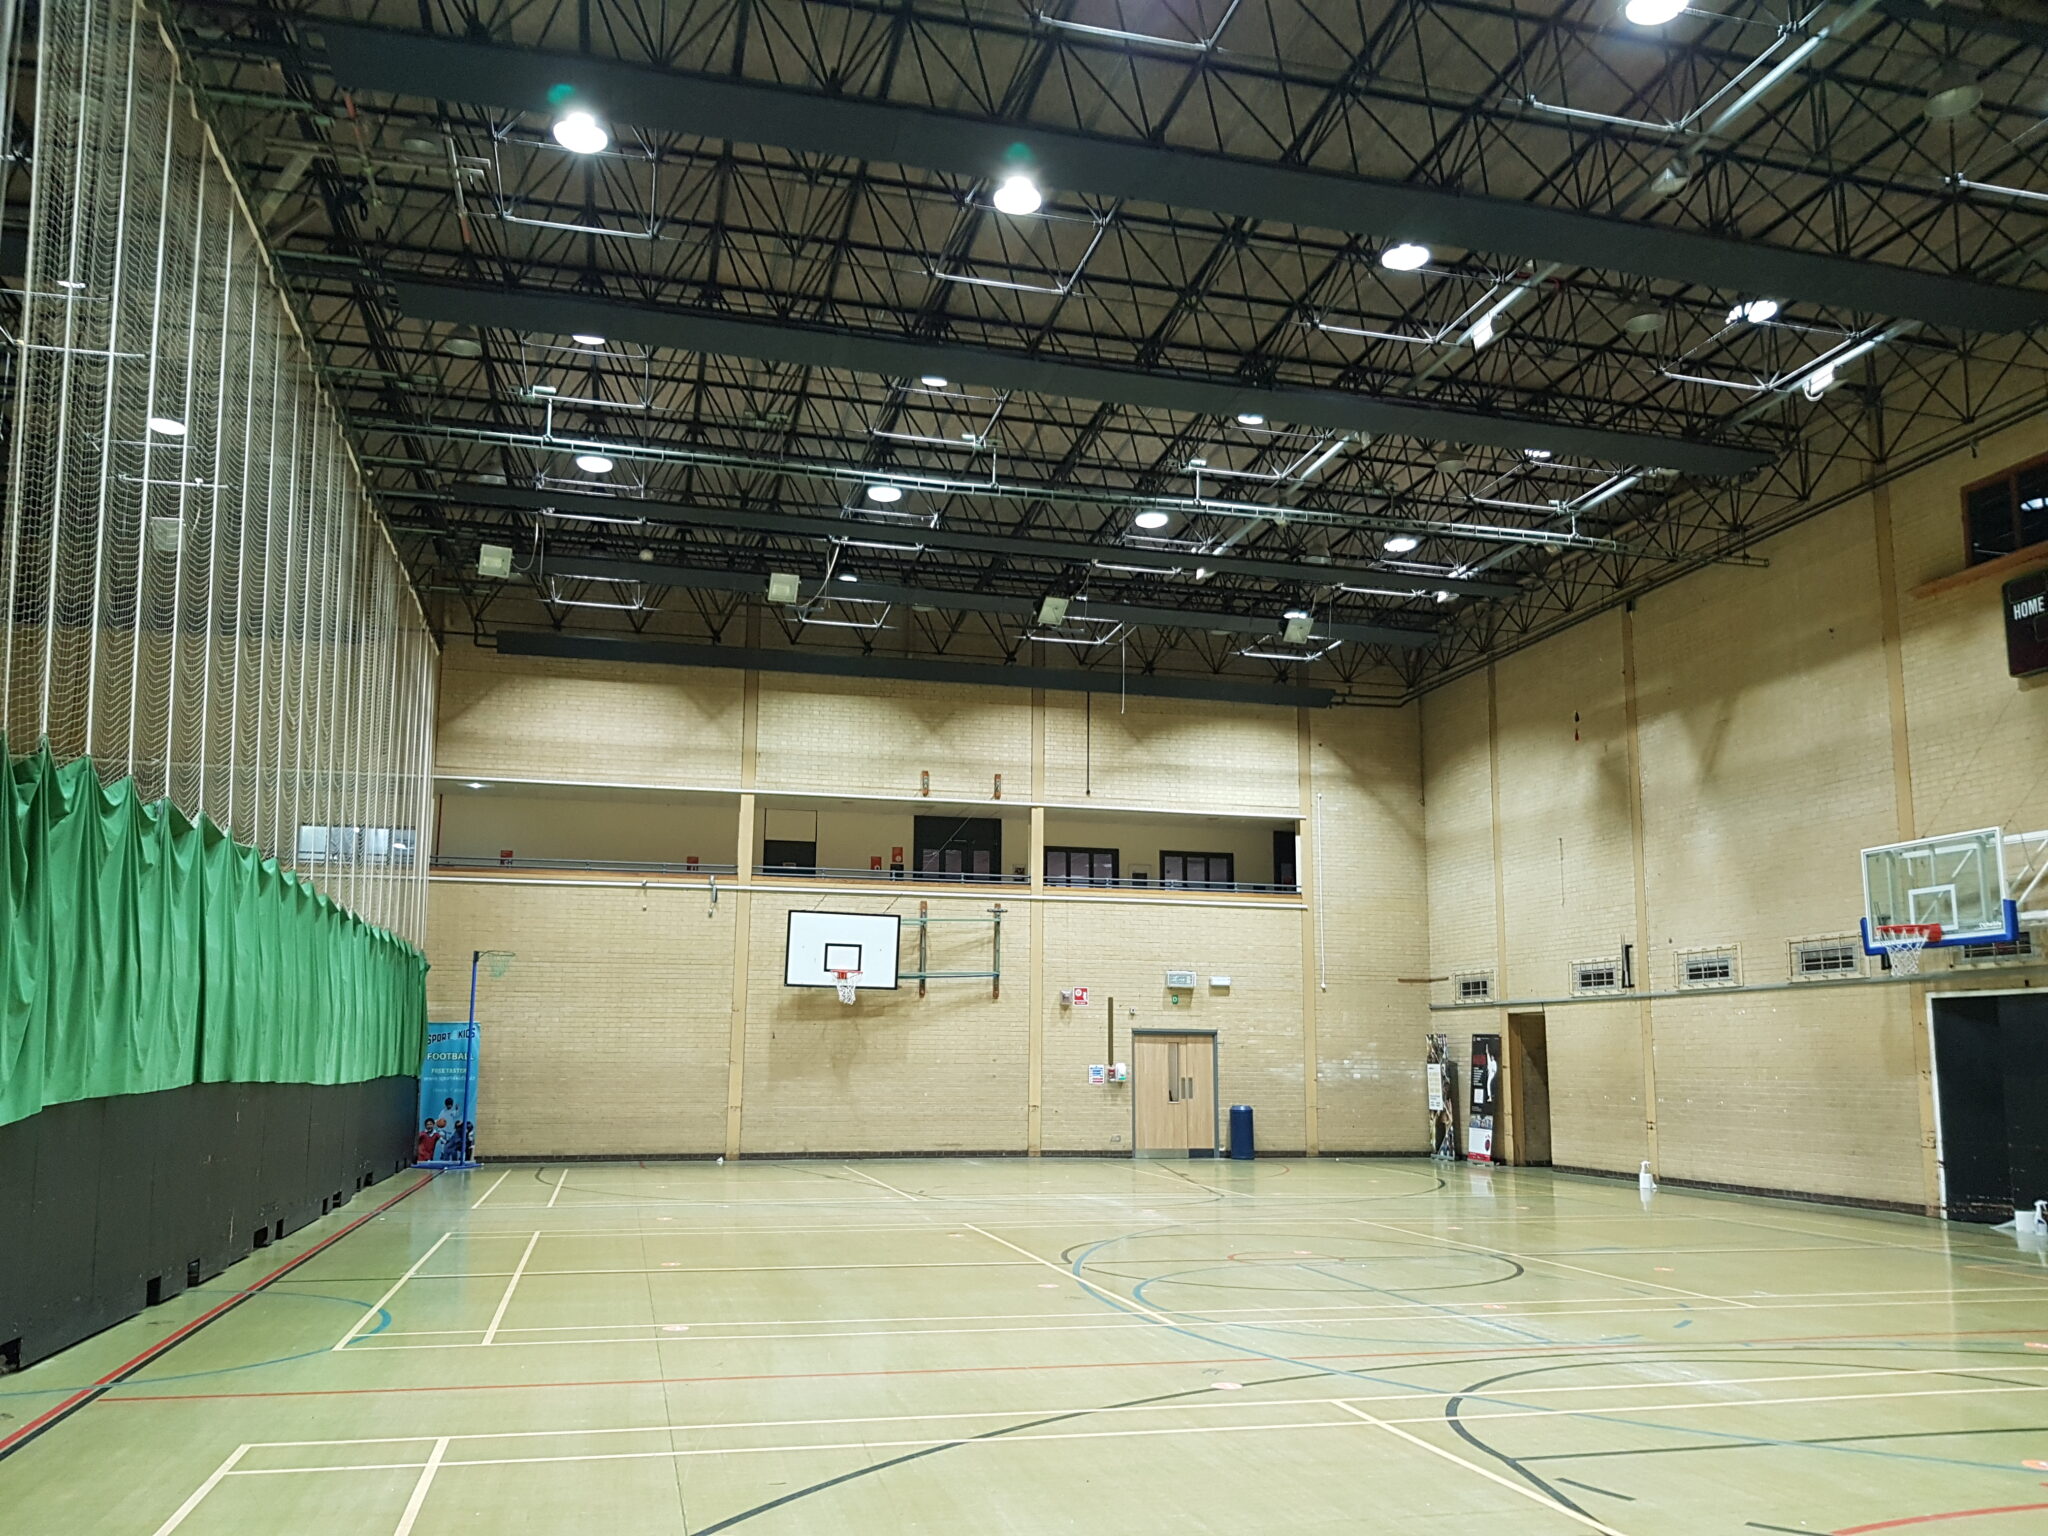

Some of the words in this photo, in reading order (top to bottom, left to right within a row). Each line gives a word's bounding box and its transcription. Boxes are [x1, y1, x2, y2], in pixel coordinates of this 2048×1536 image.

[2013, 596, 2045, 620] HOME
[427, 1032, 451, 1045] SPORT
[458, 1028, 475, 1039] KIDS
